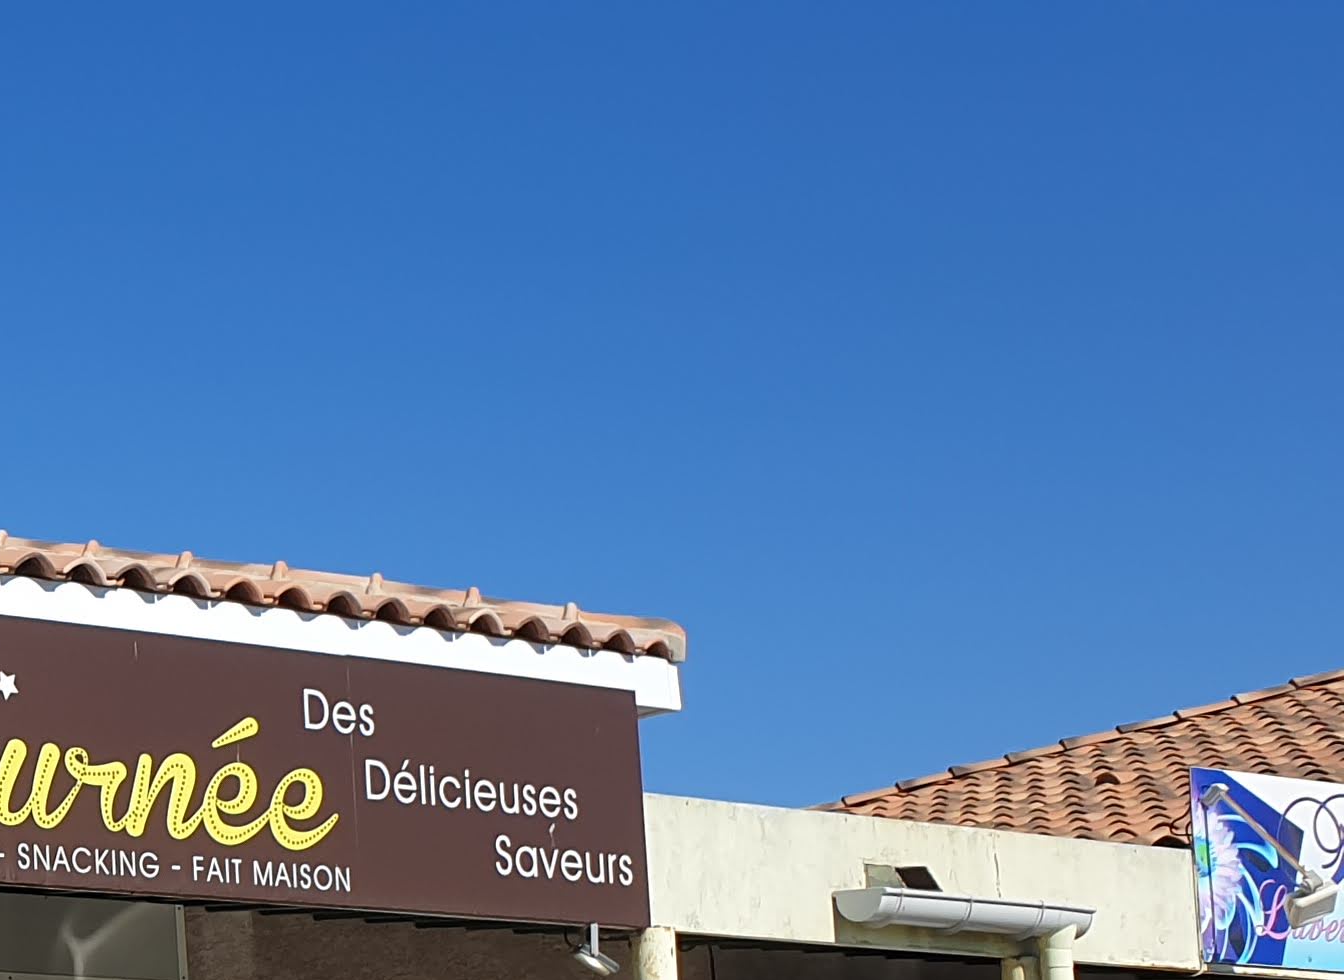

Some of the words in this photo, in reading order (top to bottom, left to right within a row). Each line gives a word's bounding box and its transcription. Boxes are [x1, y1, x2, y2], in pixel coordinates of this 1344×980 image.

[303, 688, 376, 737] Des
[365, 758, 578, 821] Délicieuses
[16, 843, 160, 879] SNACKING
[192, 855, 243, 885] FAIT
[253, 860, 352, 893] MAISON
[495, 834, 634, 886] Saveurs
